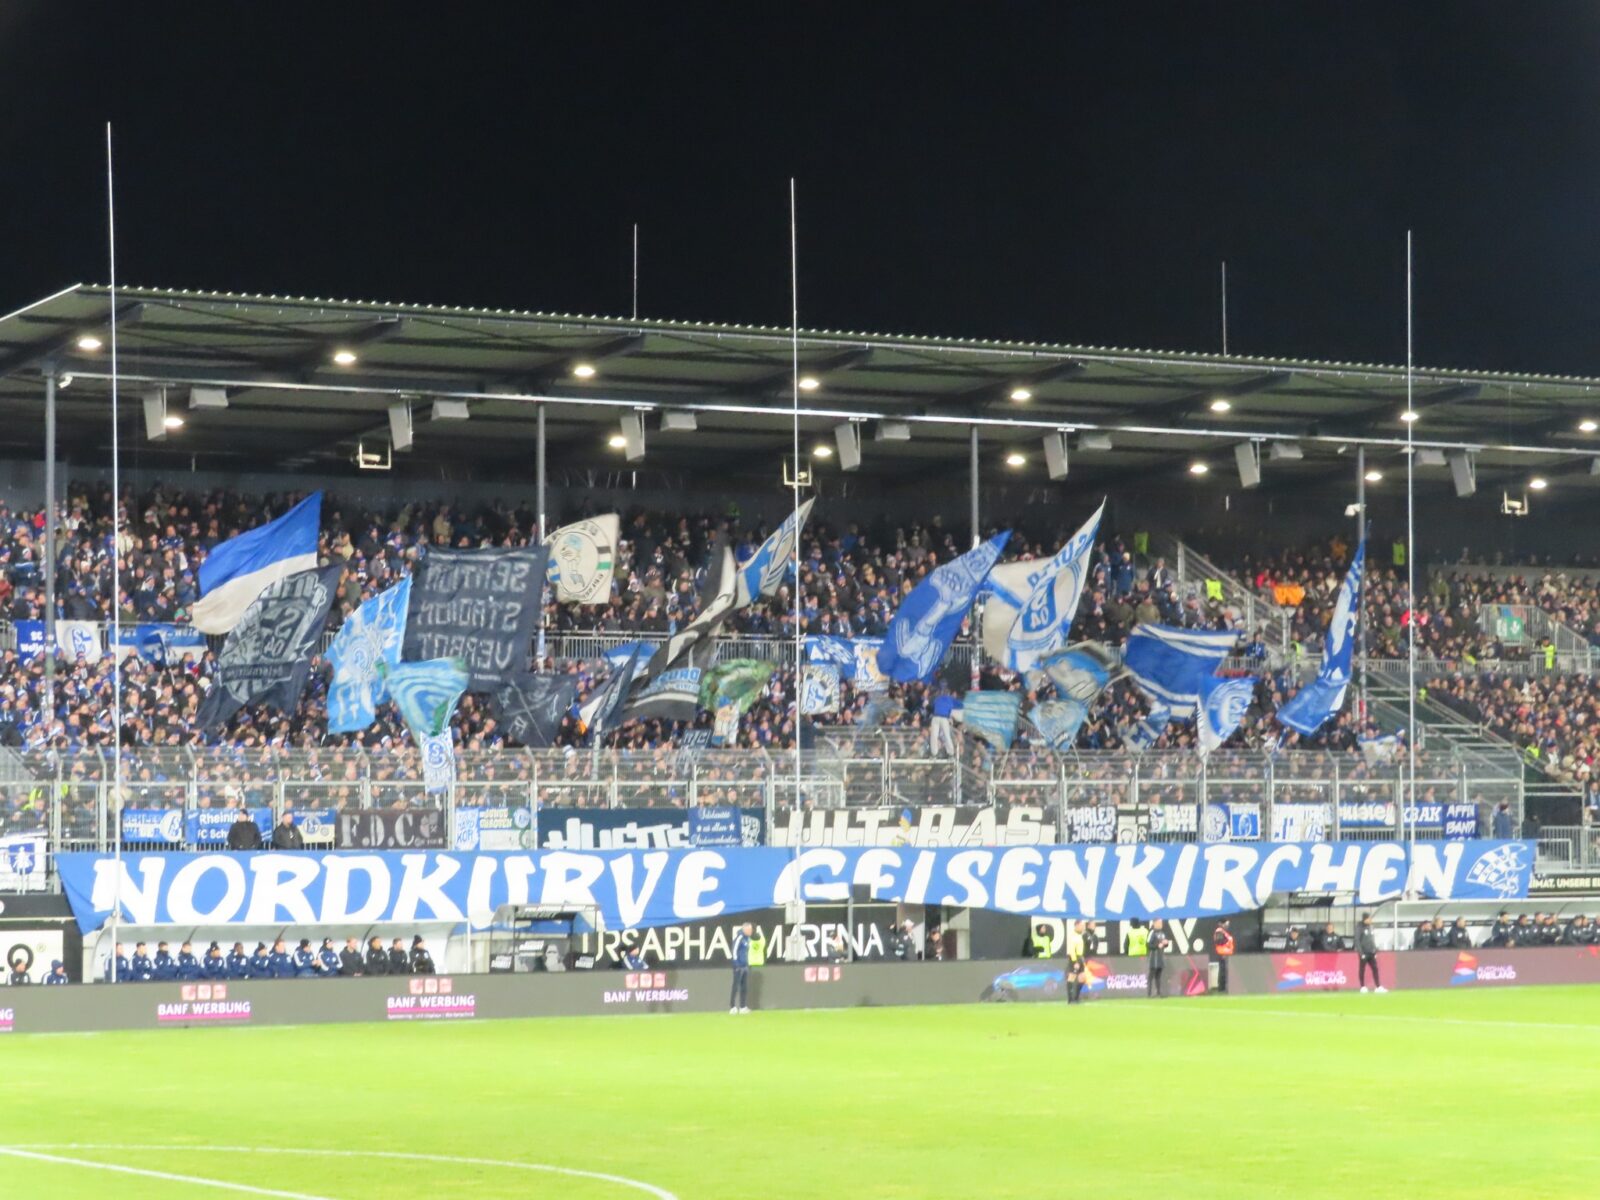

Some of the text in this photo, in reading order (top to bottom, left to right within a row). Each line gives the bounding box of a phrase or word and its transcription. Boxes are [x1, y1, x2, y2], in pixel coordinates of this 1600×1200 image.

[1066, 806, 1116, 826] MARLER
[91, 853, 727, 930] NORDKURVE
[1305, 976, 1347, 985] WEILAND
[1476, 971, 1516, 980] WEILAND
[387, 995, 475, 1008] BANF WERBUNG
[604, 989, 688, 1002] BANF WERBUNG
[158, 1001, 251, 1015] BANF WERBUNG
